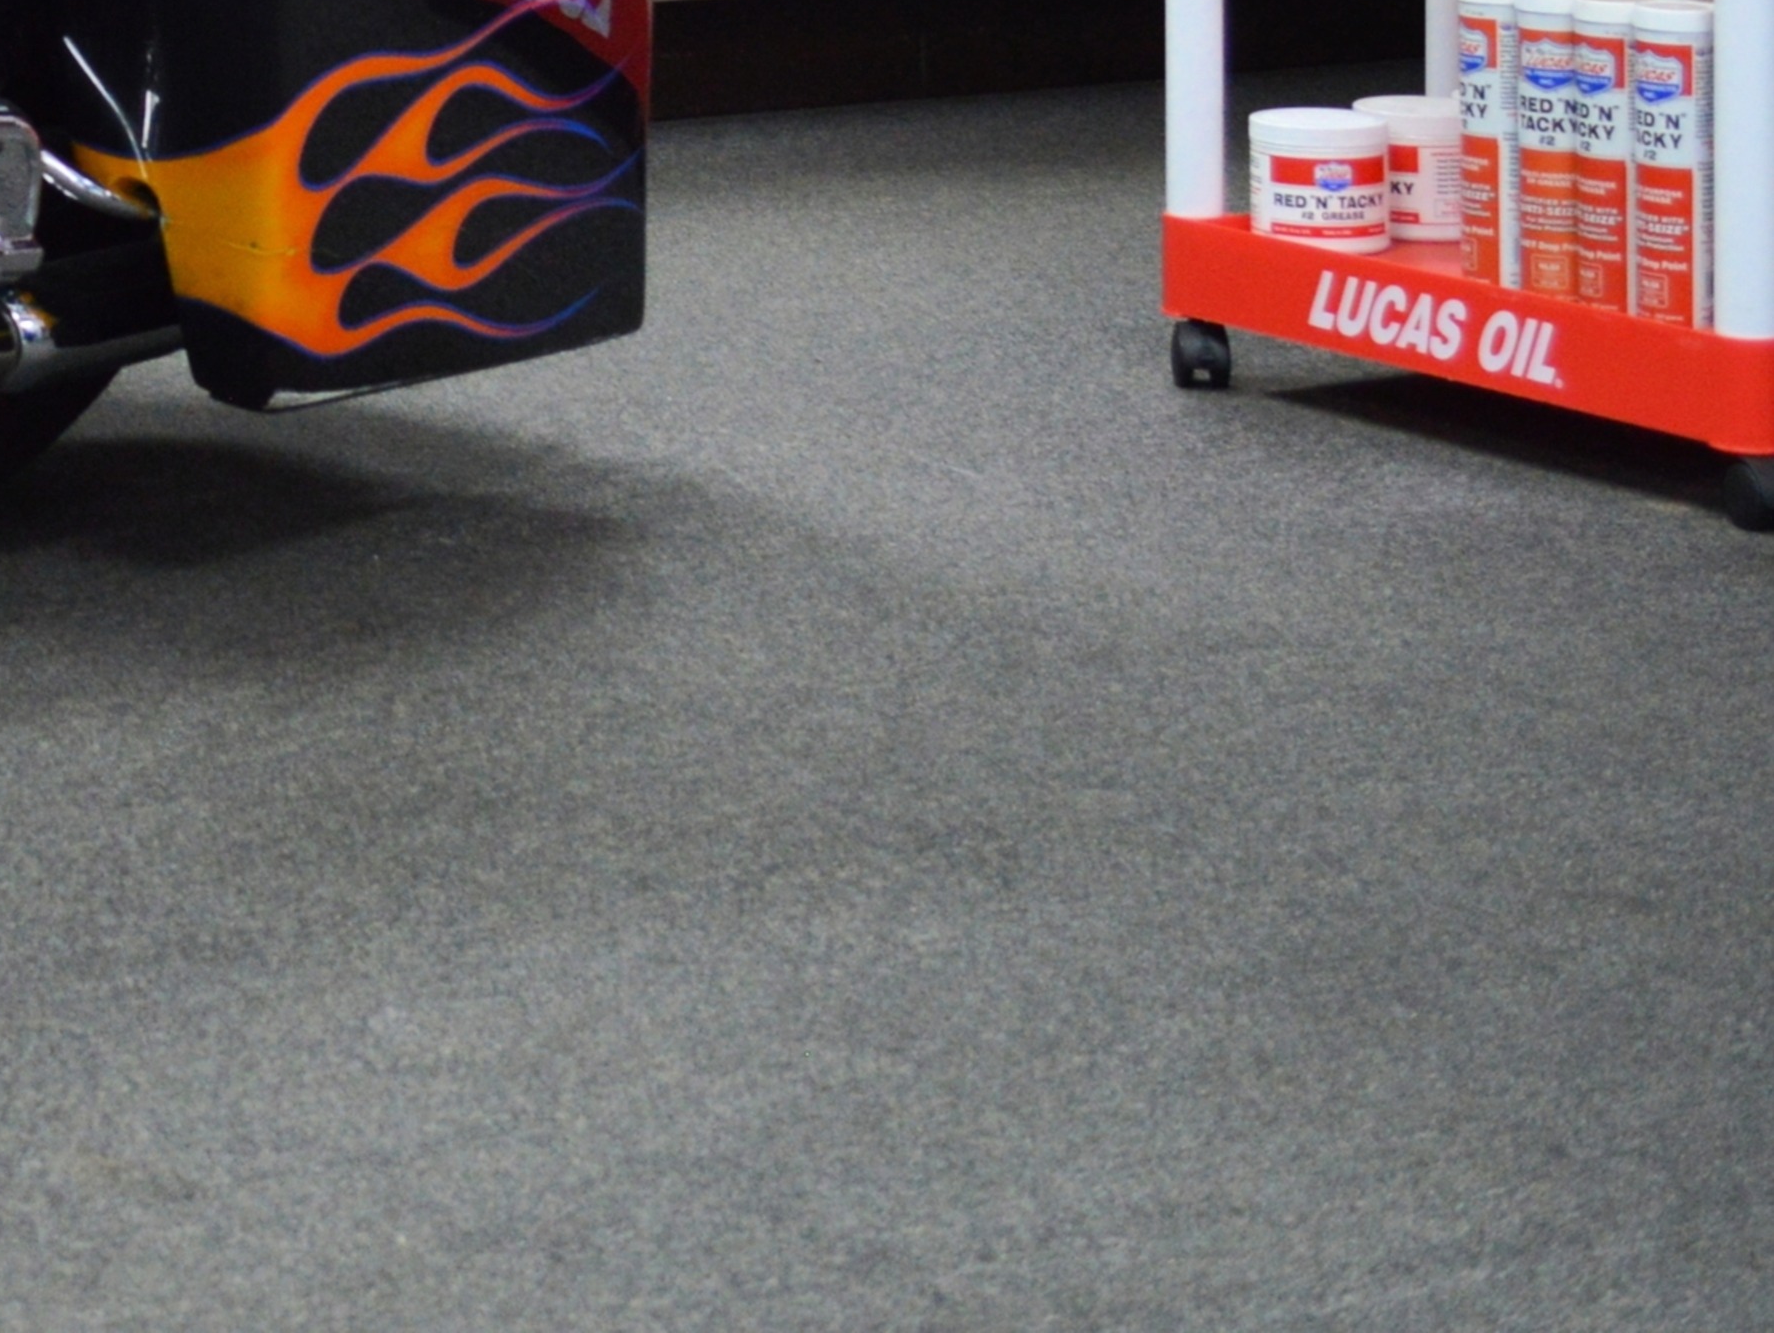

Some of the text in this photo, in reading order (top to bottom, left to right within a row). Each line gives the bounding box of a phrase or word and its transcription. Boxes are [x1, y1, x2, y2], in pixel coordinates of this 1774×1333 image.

[1577, 58, 1608, 77] UCAS
[1637, 67, 1676, 83] UCAS
[1461, 103, 1488, 119] CKY
[1520, 95, 1553, 112] RED
[1520, 117, 1578, 134] TACKY
[1577, 122, 1615, 142] CKY
[1637, 131, 1683, 150] ACKY
[1273, 192, 1307, 209] RED
[1339, 193, 1384, 209] TACKY
[1321, 211, 1365, 221] GREASE
[1308, 270, 1557, 386] LUCAS OIL
